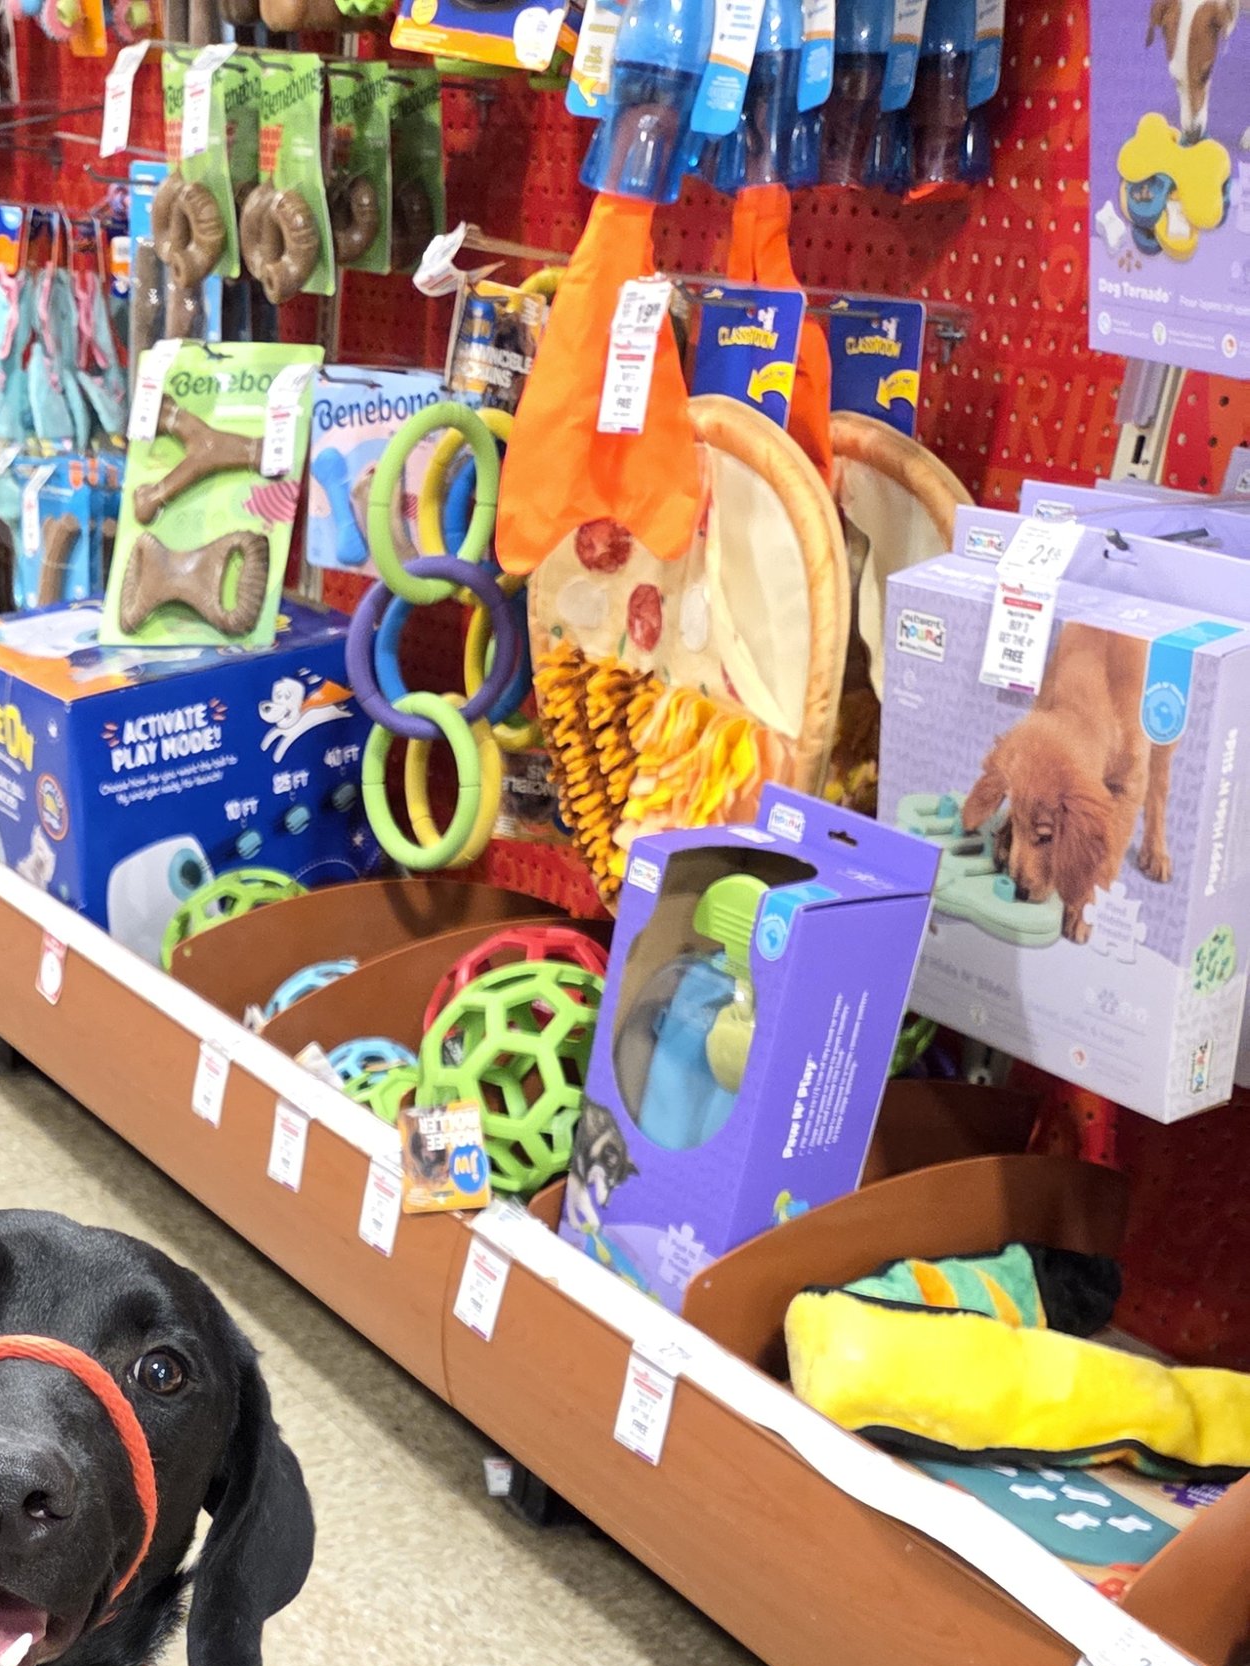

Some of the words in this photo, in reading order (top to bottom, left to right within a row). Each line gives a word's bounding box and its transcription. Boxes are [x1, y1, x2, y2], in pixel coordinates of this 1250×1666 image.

[1098, 277, 1121, 299] Dog
[1121, 281, 1170, 304] Tornado
[170, 369, 274, 397] Benebo
[312, 391, 438, 431] Benebone
[900, 619, 945, 649] hound
[1002, 647, 1025, 664] FREE
[123, 703, 208, 745] ACTIVATE
[111, 740, 158, 773] PLAY
[161, 725, 222, 761] MODE!
[344, 744, 360, 763] FT
[1221, 728, 1239, 774] Slide
[292, 769, 310, 789] FT
[242, 797, 259, 816] FT
[1212, 798, 1229, 841] Hide
[1204, 842, 1224, 896] Puppy
[782, 1120, 800, 1160] Paw
[796, 1058, 818, 1099] Play
